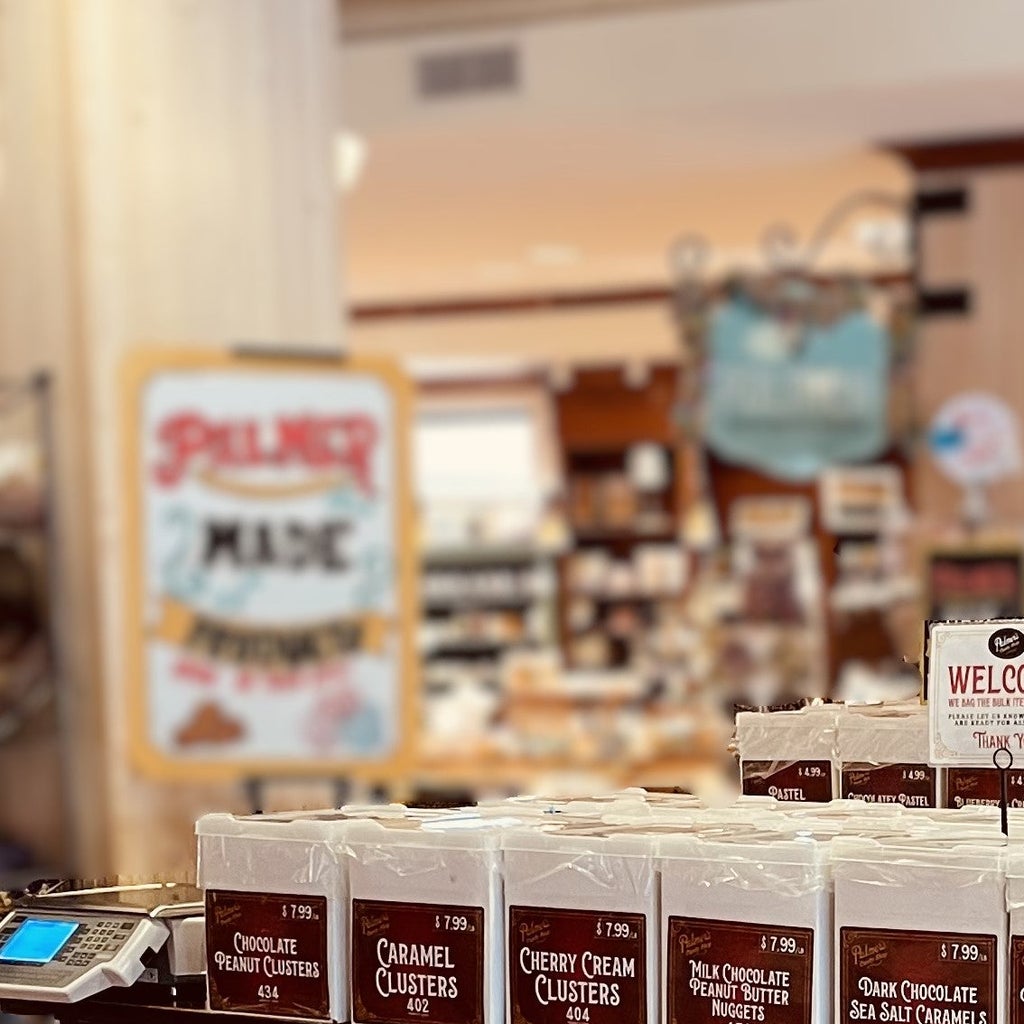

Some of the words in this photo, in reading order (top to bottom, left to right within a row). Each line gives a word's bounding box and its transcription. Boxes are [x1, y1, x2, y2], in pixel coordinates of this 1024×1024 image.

[948, 698, 959, 707] WE
[961, 698, 975, 707] BAG
[977, 698, 990, 707] THE
[992, 698, 1010, 707] BULK
[973, 731, 1010, 749] THANK
[768, 785, 806, 800] PASTEL
[898, 793, 929, 806] PASTEL
[233, 932, 297, 955] CHOCOLATE
[377, 938, 455, 969] CARAMEL
[214, 951, 260, 974] PEANUT
[263, 954, 320, 978] CLUSTERS
[520, 947, 577, 974] CHERRY
[581, 951, 635, 979] CREAM
[689, 960, 719, 980] MILK
[722, 963, 790, 987] CHOCOLATE
[258, 985, 279, 999] 434
[376, 967, 458, 999] CLUSTERS
[535, 974, 620, 1006] CLUSTERS
[689, 977, 738, 1000] PEANUT
[741, 983, 789, 1006] BUTTER
[858, 977, 897, 998] DARK
[901, 980, 978, 1004] CHOCOLATE
[406, 998, 430, 1013] 402
[566, 1006, 590, 1022] 404
[711, 999, 765, 1021] NUGGETS
[850, 1000, 876, 1020] SEA
[879, 1002, 912, 1023] SALT
